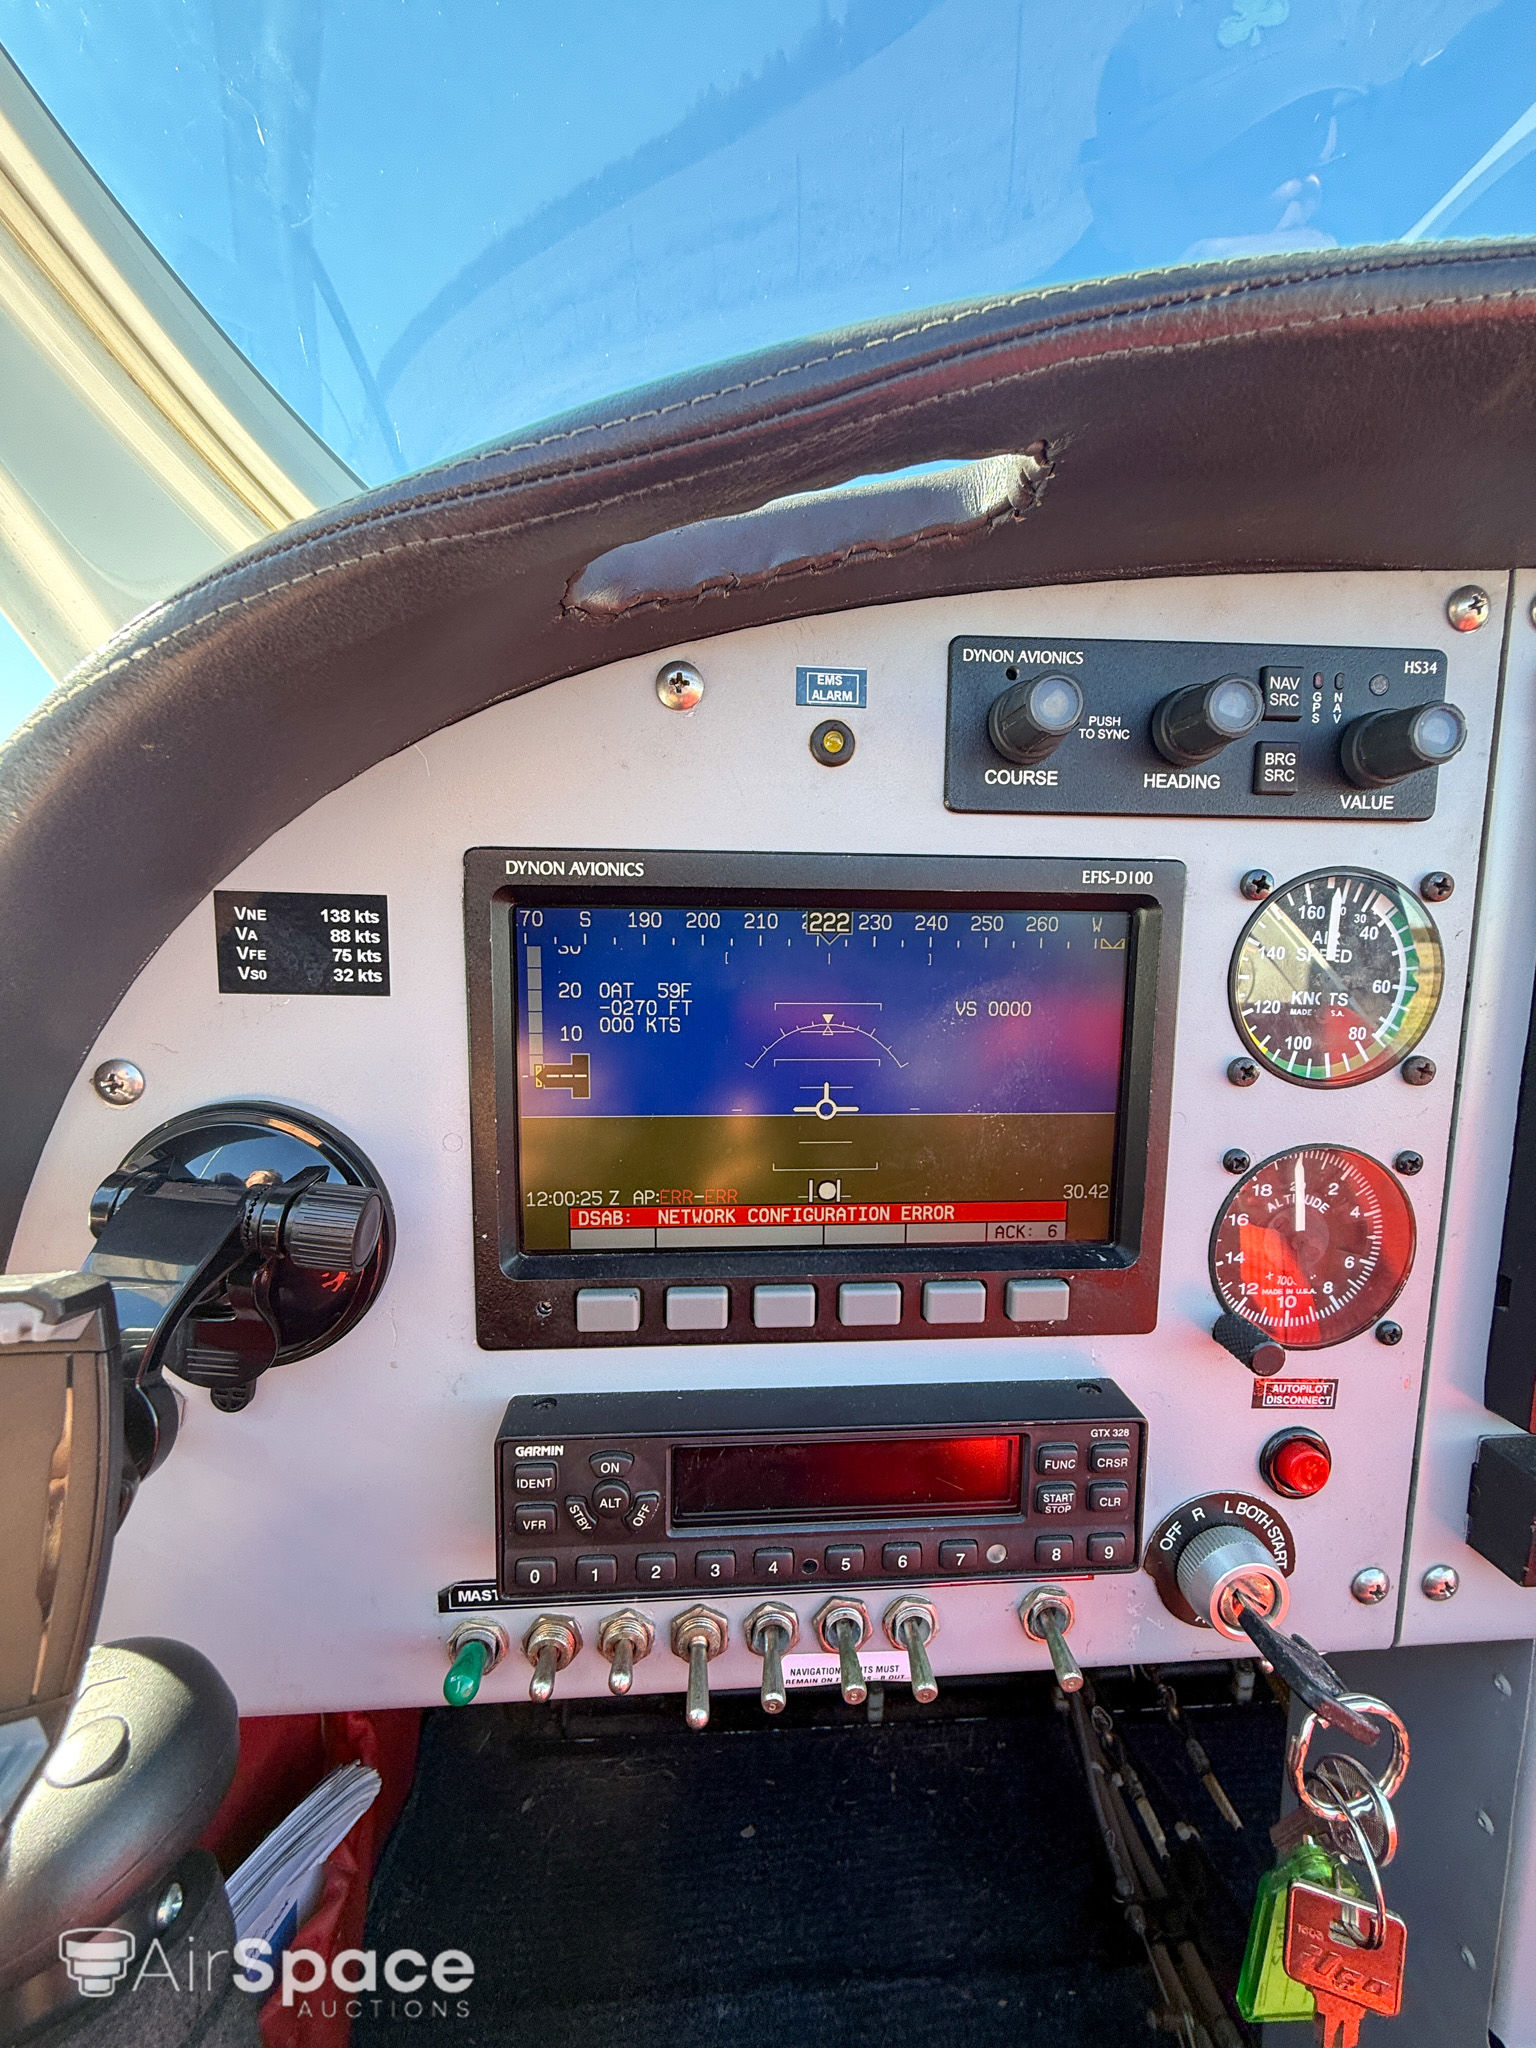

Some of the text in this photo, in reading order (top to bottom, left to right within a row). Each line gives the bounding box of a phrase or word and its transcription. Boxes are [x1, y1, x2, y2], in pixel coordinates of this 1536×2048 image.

[963, 648, 1084, 665] DYNON AVIONICS
[1404, 661, 1438, 675] HS34
[817, 675, 843, 686] EMS
[1270, 676, 1300, 690] NAV
[811, 689, 853, 702] ALARM
[1269, 693, 1300, 707] SRC
[1088, 716, 1121, 727] PUSH
[1079, 728, 1131, 740] TO SYNC
[1264, 753, 1296, 766] BRG
[984, 769, 1059, 786] COURSE
[1143, 773, 1221, 791] HEADING
[1264, 769, 1295, 782] SRC
[1339, 795, 1394, 810] VALUE
[505, 860, 645, 877] DYNON AVIONICS
[1081, 870, 1154, 885] EFIS-D100
[320, 909, 351, 923] 138
[354, 909, 380, 924] kts
[1298, 905, 1325, 920] 160
[1353, 914, 1367, 924] 30
[516, 910, 544, 927] 70
[579, 911, 592, 928] S
[627, 911, 662, 928] 190
[685, 912, 721, 929] 200
[743, 912, 779, 930] 210
[809, 912, 850, 932] 222
[858, 914, 892, 931] 230
[914, 915, 948, 932] 240
[970, 916, 1004, 932] 250
[1025, 916, 1059, 932] 260
[1092, 917, 1102, 932] W
[234, 926, 381, 944] VA 88 kts
[1359, 926, 1379, 940] 40
[236, 946, 382, 963] VFE 75 kts
[1259, 947, 1286, 961] 140
[333, 968, 354, 983] 32
[357, 969, 383, 983] kts
[558, 982, 582, 999] 20
[599, 982, 692, 998] OAT 59F
[1372, 980, 1391, 994] 60
[599, 1000, 693, 1016] -0270 FT
[955, 1001, 1032, 1017] VS 0000
[1254, 1000, 1281, 1015] 120
[599, 1017, 681, 1033] 000 KTS
[560, 1025, 583, 1042] 10
[1348, 1026, 1367, 1041] 80
[1284, 1036, 1312, 1050] 100
[1062, 1183, 1109, 1200] 30.42
[1252, 1183, 1273, 1197] 18
[1328, 1182, 1339, 1196] 2
[526, 1190, 603, 1207] 12:00:25
[608, 1190, 620, 1206] Z
[1267, 1193, 1331, 1214] ALTIUDE
[578, 1205, 955, 1226] DSAB: NETWORK CONFIGURATION ERROR
[1350, 1206, 1360, 1218] 4
[1228, 1213, 1249, 1226] 16
[994, 1224, 1058, 1239] ACK: 6
[1224, 1251, 1246, 1264] 14
[1344, 1256, 1355, 1269] 6
[1238, 1282, 1259, 1295] 12
[1322, 1281, 1334, 1294] 8
[1277, 1295, 1297, 1309] 10
[1271, 1384, 1329, 1394] AUTOPILOT
[1266, 1395, 1332, 1405] DISCONNECT
[1090, 1428, 1130, 1438] GTX 328
[515, 1445, 564, 1457] GARMIN
[600, 1462, 620, 1474] ON
[1044, 1459, 1076, 1470] FUNC
[1096, 1457, 1128, 1468] CRSR
[516, 1477, 553, 1489] IDENT
[599, 1497, 622, 1509] ALT
[1043, 1493, 1074, 1503] START
[1099, 1497, 1121, 1507] CLR
[632, 1503, 651, 1527] OFF
[1045, 1505, 1072, 1514] STOP
[522, 1519, 547, 1530] VFR
[569, 1504, 592, 1532] STBY
[1159, 1500, 1288, 1570] OFF R L BOTH START
[529, 1545, 1114, 1584] 0 1 2 3 4 5 6 7 8 9
[790, 1667, 840, 1676] NAVIGATION
[875, 1664, 899, 1674] MUST
